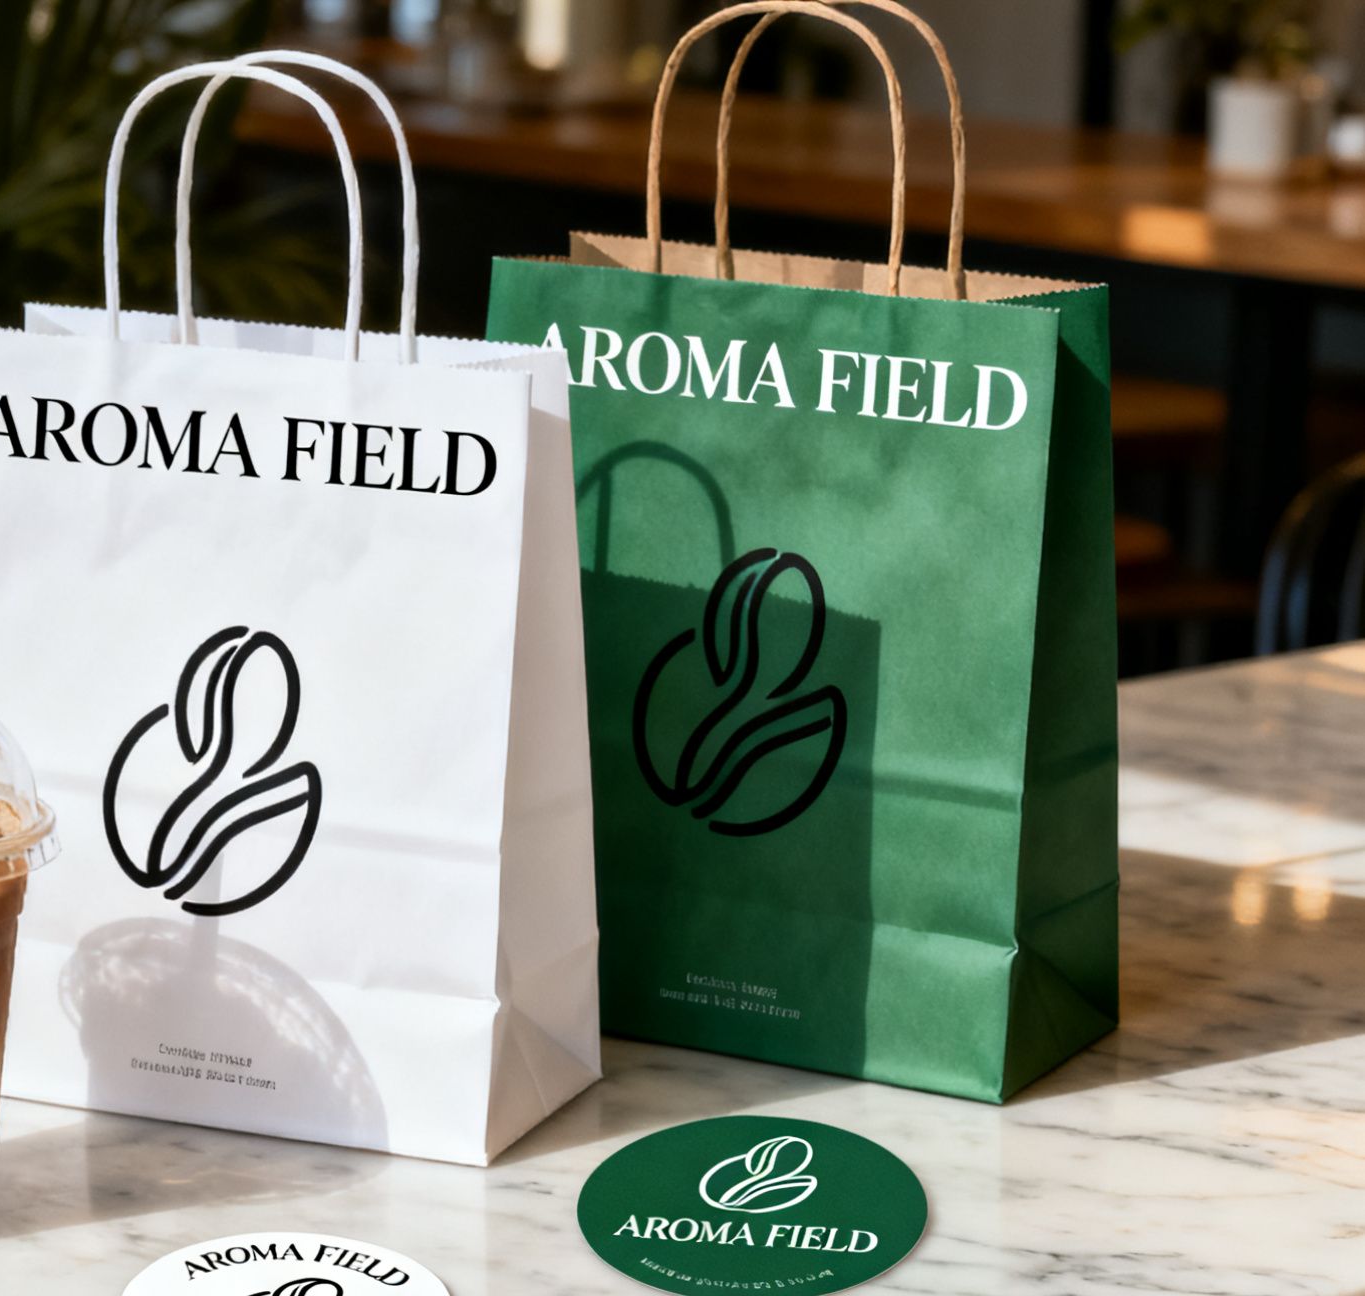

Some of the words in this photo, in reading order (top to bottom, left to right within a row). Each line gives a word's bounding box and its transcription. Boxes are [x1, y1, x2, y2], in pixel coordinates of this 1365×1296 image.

[815, 348, 1029, 431] FIELD
[281, 416, 498, 497] FIELD
[613, 1213, 754, 1247] AROMA
[764, 1224, 879, 1254] FIELD
[183, 1243, 304, 1281] AROMA
[313, 1243, 411, 1288] FIELD
